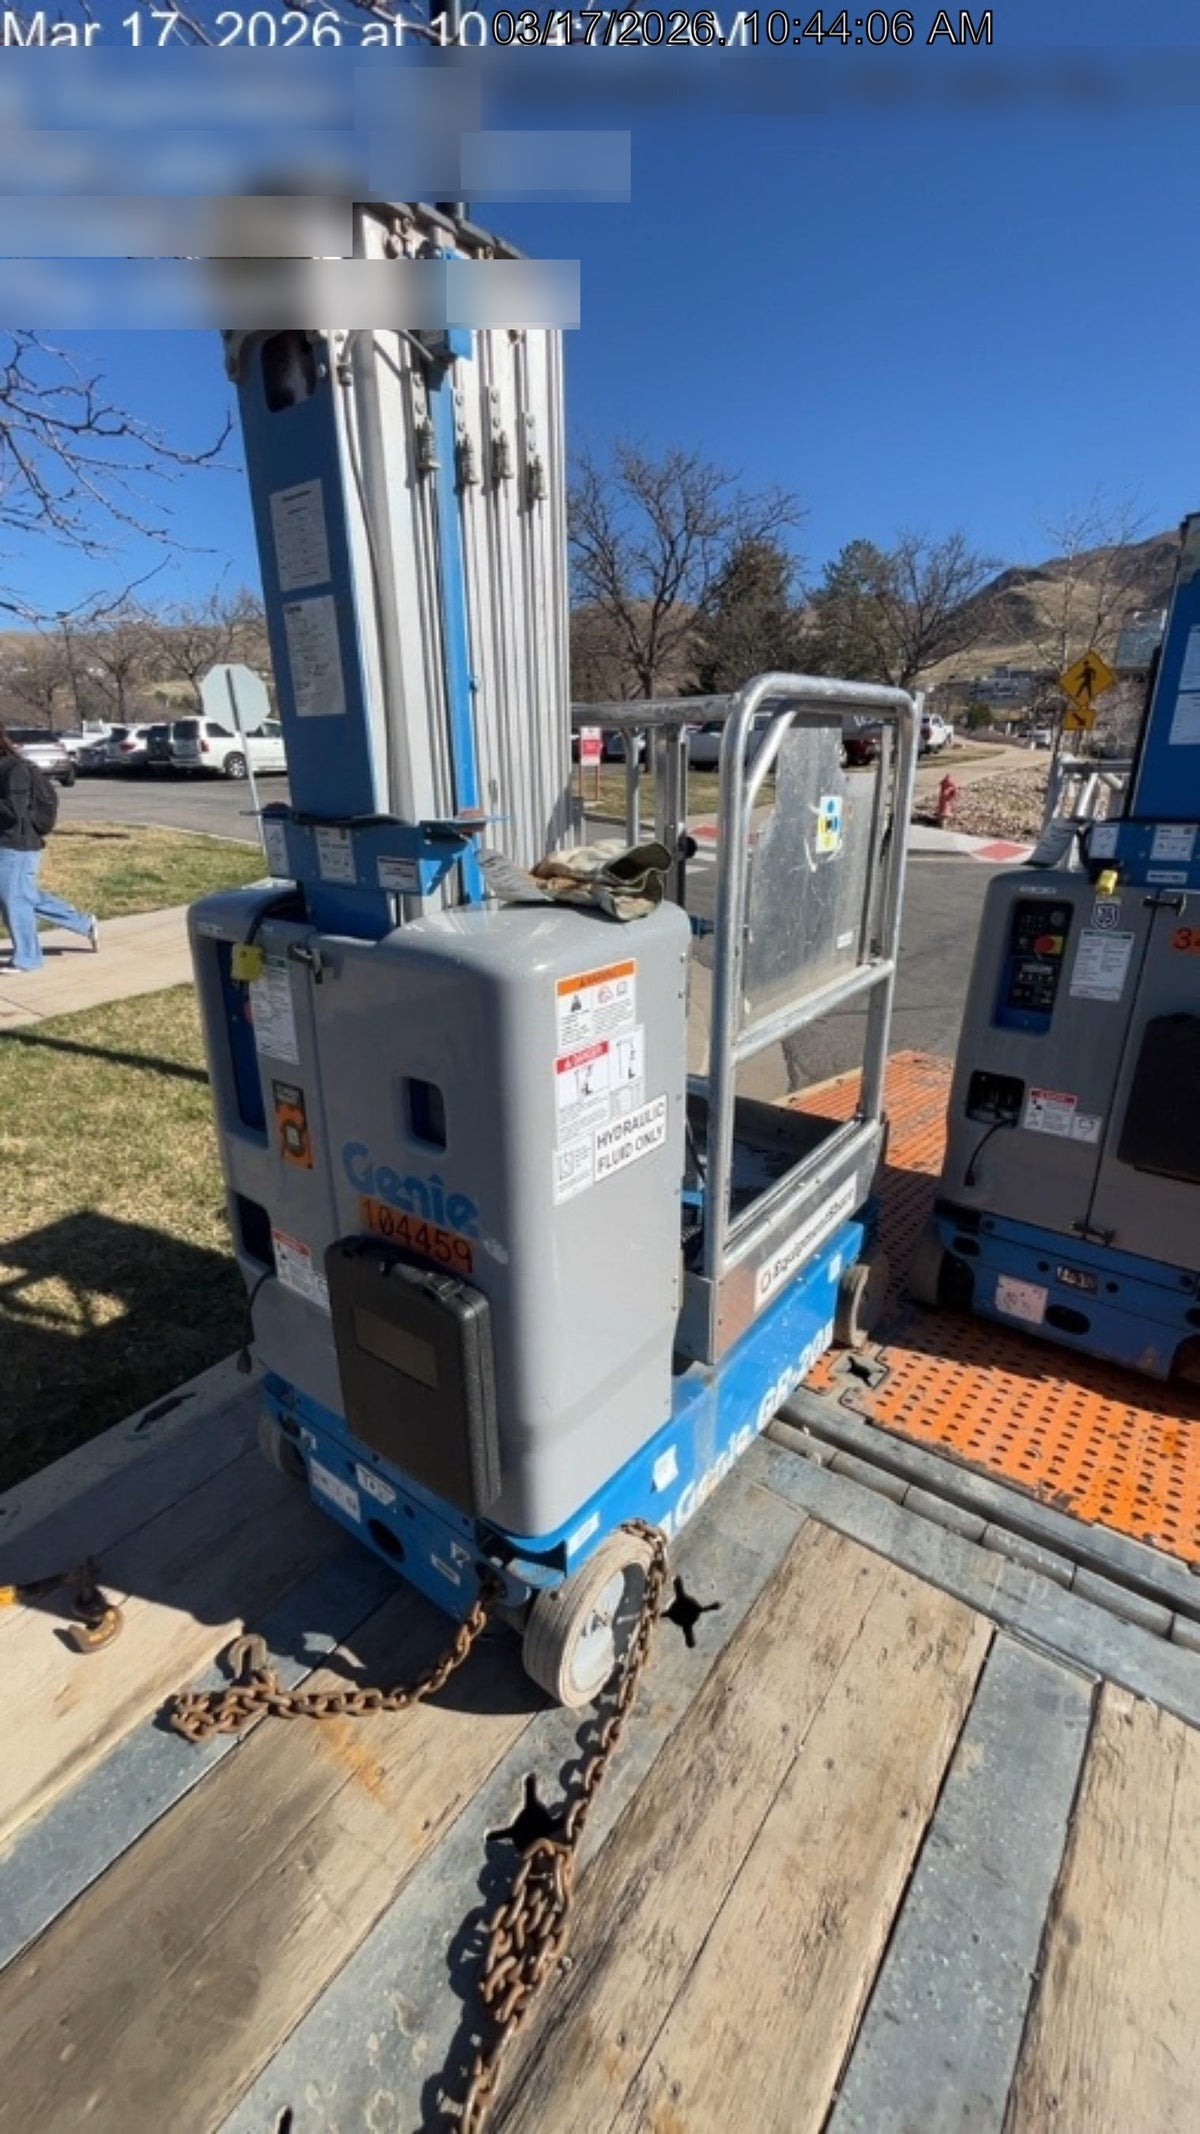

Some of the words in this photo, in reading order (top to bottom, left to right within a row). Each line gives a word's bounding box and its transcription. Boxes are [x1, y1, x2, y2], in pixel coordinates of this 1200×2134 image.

[1173, 926, 1200, 951] 3
[596, 1101, 665, 1150] HYDRAULIC
[597, 1142, 634, 1173] FLUID
[634, 1125, 663, 1152] ONLY
[342, 1140, 480, 1240] Genie
[361, 1198, 475, 1275] 104459
